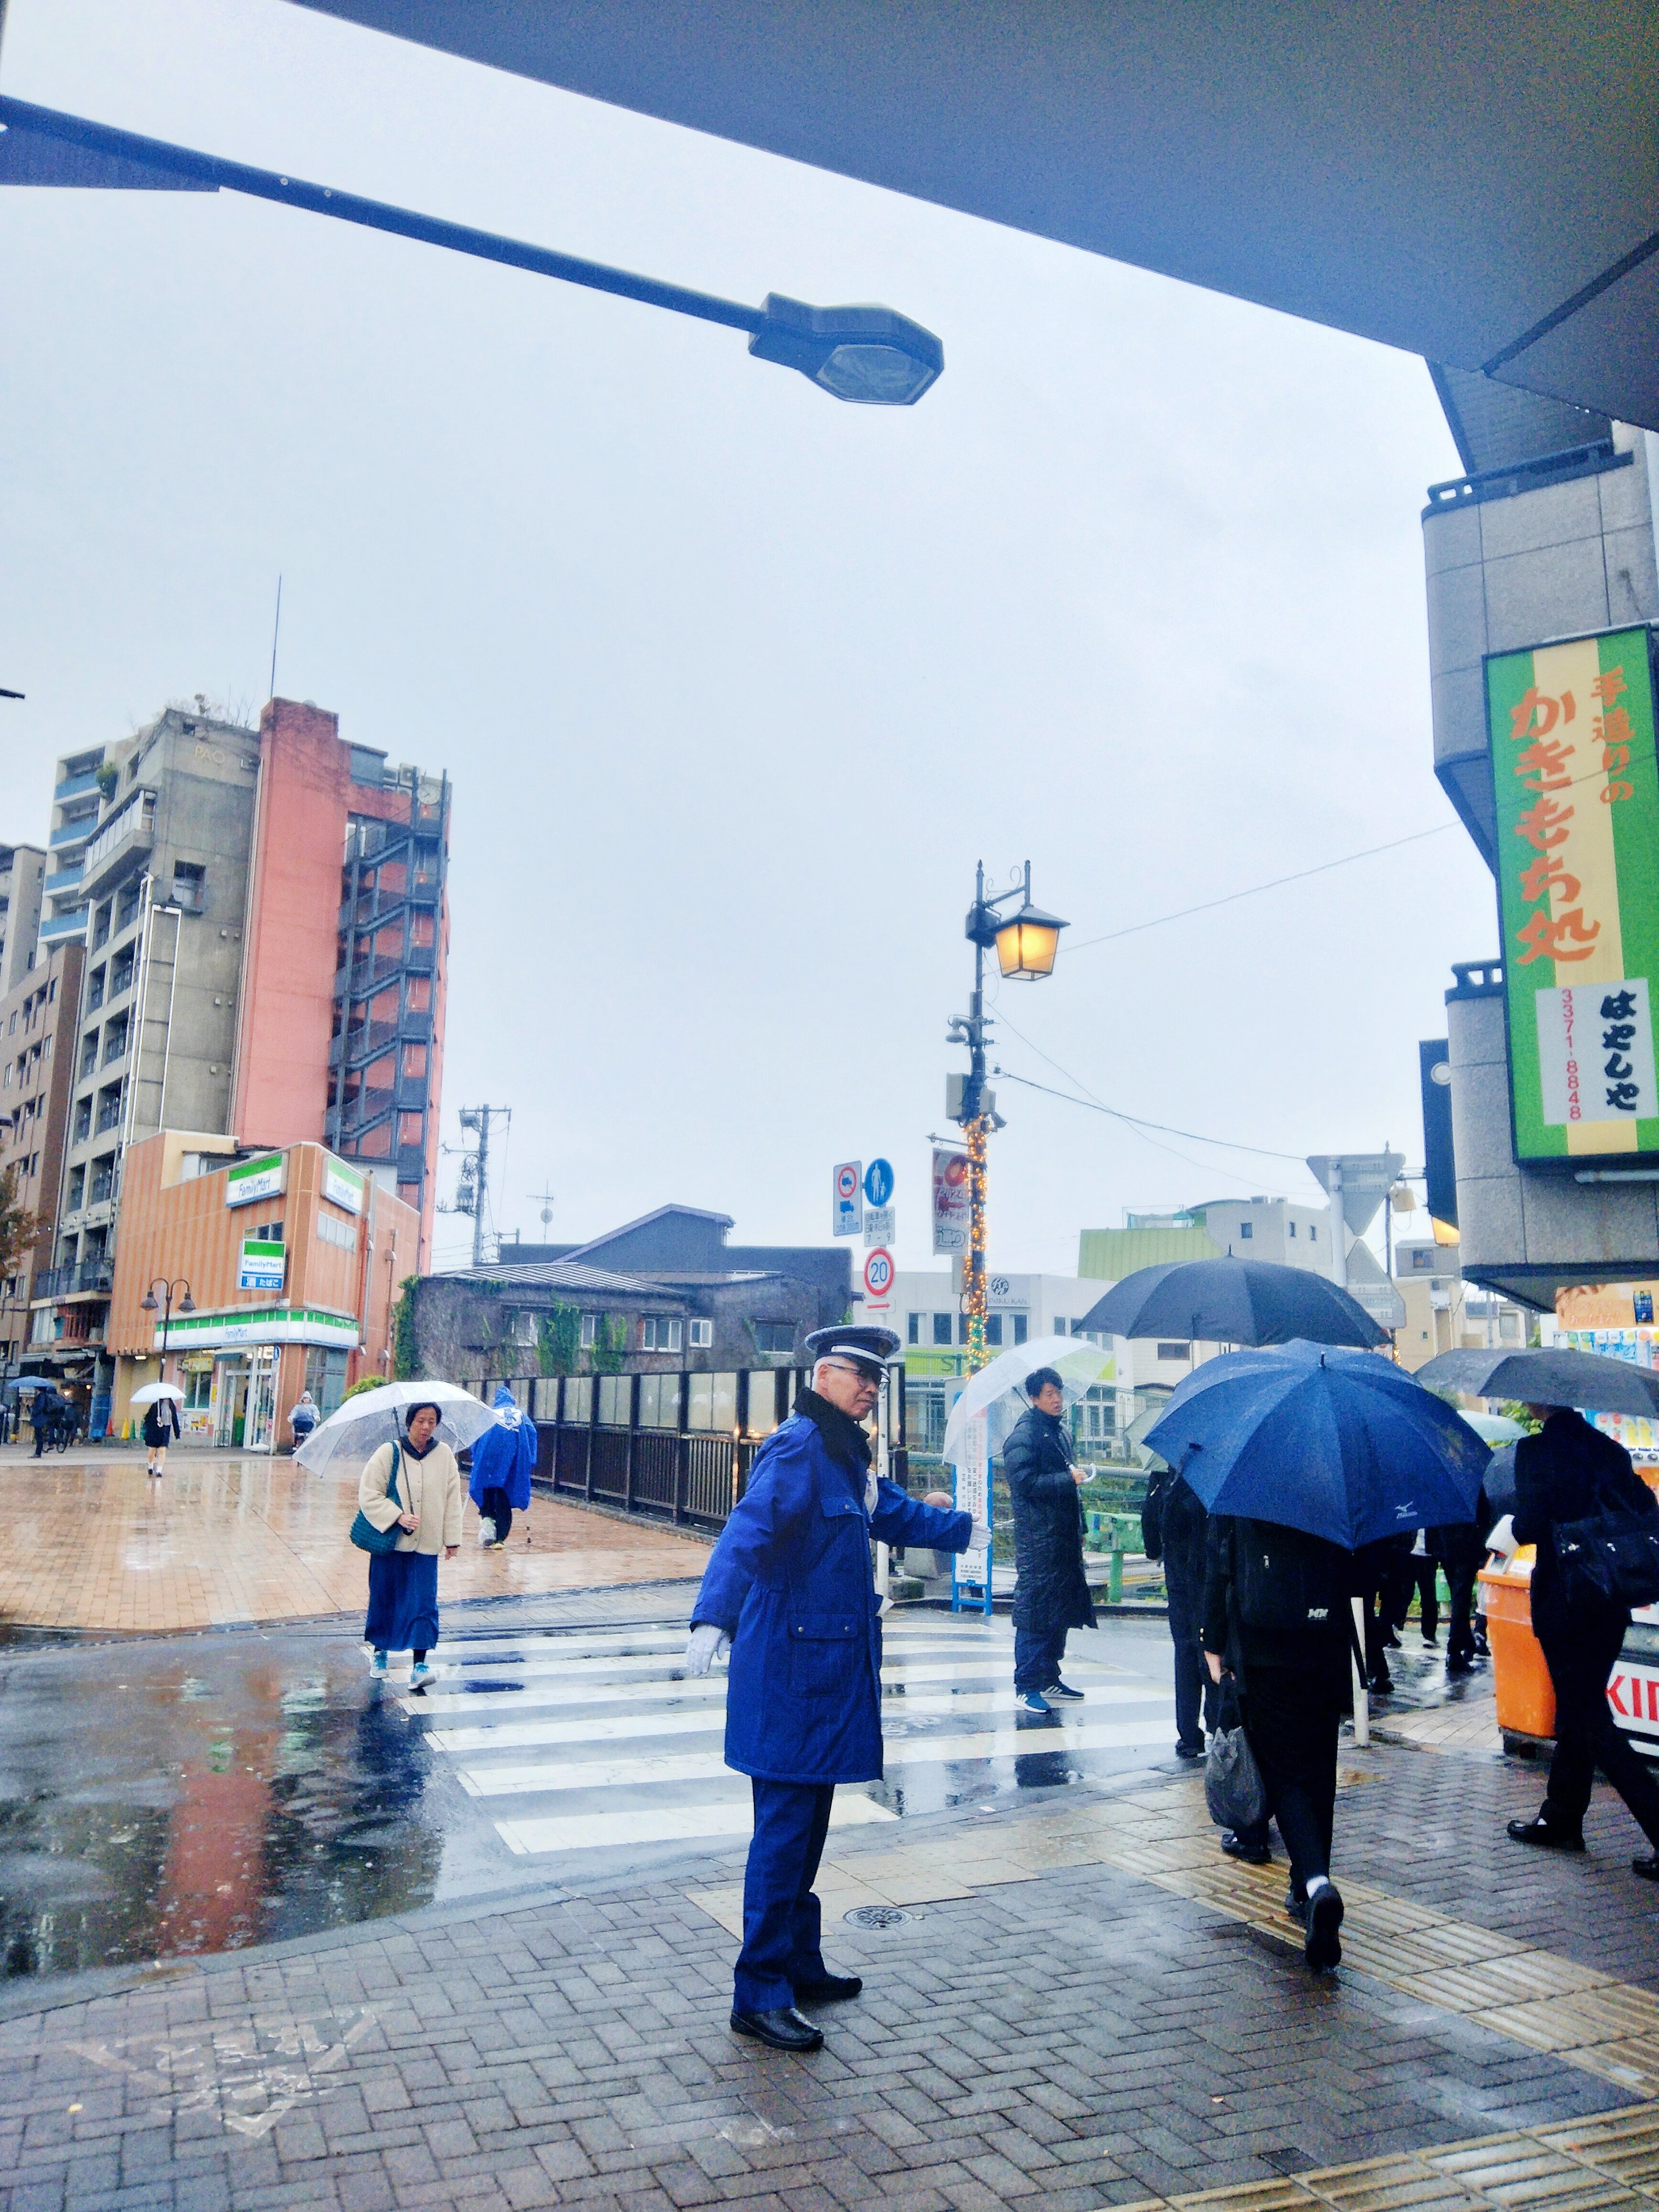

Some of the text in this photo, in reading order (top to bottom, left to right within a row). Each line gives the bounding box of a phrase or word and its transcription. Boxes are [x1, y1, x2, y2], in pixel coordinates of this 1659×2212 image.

[1590, 665, 1635, 804] 手造りの
[195, 745, 225, 764] PAO
[1510, 687, 1601, 965] かきもち処
[1562, 988, 1581, 1121] 3371-8848
[1600, 989, 1640, 1112] はやしや
[239, 1176, 271, 1197] FamilyMart
[245, 1259, 281, 1269] FamilyMart
[871, 1261, 887, 1283] 20
[225, 1327, 248, 1341] FamilyMart
